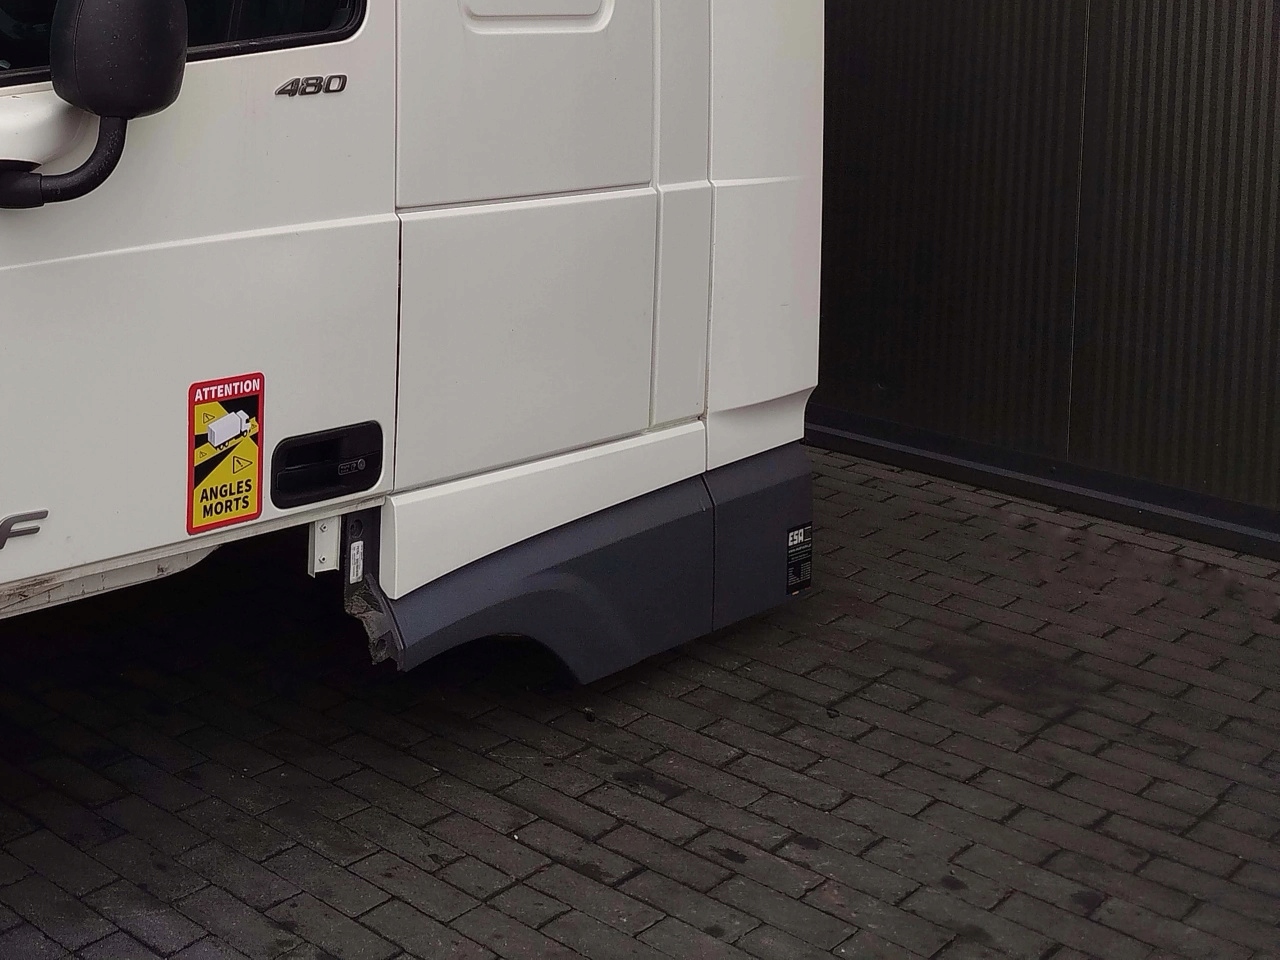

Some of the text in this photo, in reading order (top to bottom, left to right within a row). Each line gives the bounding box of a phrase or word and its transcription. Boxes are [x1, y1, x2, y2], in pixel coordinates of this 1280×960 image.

[274, 74, 348, 97] 480
[194, 378, 261, 402] ATTENTION
[200, 478, 253, 503] ANGLES
[202, 495, 250, 519] MORTS
